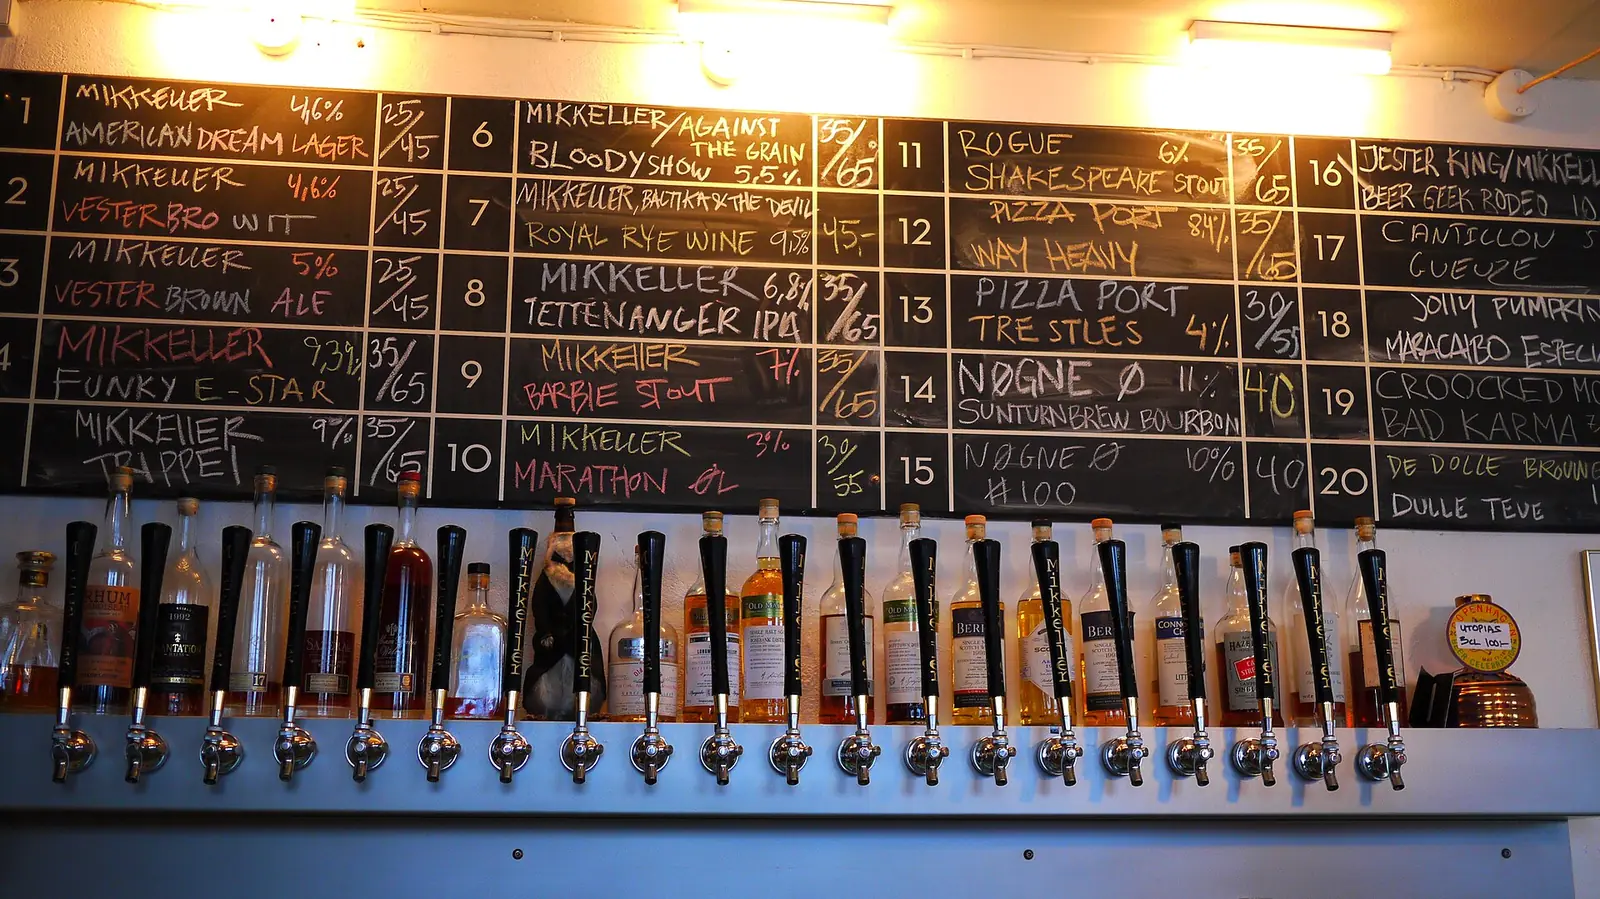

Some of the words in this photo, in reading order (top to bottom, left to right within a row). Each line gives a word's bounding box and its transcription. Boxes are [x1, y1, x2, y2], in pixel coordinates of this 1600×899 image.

[20, 97, 31, 124] 1
[76, 83, 244, 112] MIKKELLER
[66, 120, 193, 149] AMERICAN
[197, 126, 284, 156] DREAM
[292, 133, 369, 162] LAGER
[472, 121, 493, 148] 6
[958, 129, 1073, 157] ROGUE
[1158, 140, 1190, 165] 6%
[690, 141, 737, 159] THE
[746, 141, 806, 166] GRAIN
[899, 142, 921, 169] 11
[1358, 145, 1440, 178] JESTER
[74, 160, 247, 193] MIKKELLER
[965, 162, 1168, 196] SHAKESPEARE
[1174, 173, 1231, 199] STOUT
[1309, 158, 1343, 187] 16
[5, 176, 29, 205] 2
[1361, 182, 1416, 212] BEER
[1423, 186, 1476, 214] GEEK
[1482, 187, 1549, 217] RODEO
[233, 213, 318, 236] WIT
[469, 199, 490, 226] 7
[989, 200, 1077, 226] PIZZA
[1089, 202, 1179, 234] PORT
[525, 221, 608, 252] ROYAL
[621, 223, 679, 253] RYE
[686, 230, 759, 256] WINE
[899, 217, 932, 247] 12
[1382, 220, 1556, 249] CANTILLON
[69, 239, 253, 275] MIKKELLER
[291, 252, 339, 281] 5%
[971, 237, 1028, 273] WAY
[1044, 238, 1139, 277] HEAVY
[1313, 235, 1345, 263] 17
[0, 259, 21, 287] 3
[541, 262, 761, 303] MIKKELLER
[1409, 251, 1540, 288] GUEUZE
[55, 279, 161, 309] VESTER
[165, 284, 251, 315] BROWN
[270, 287, 333, 318] ALE
[464, 278, 486, 307] 8
[975, 277, 1084, 312] PIZZA
[1097, 280, 1190, 318] PORT
[899, 296, 934, 324] 13
[1317, 310, 1351, 338] 18
[753, 310, 802, 344] IPA
[1185, 313, 1230, 356] 4%
[57, 324, 274, 368] MIKKELLER
[461, 359, 484, 389] 9
[756, 347, 802, 385] 7%
[53, 367, 177, 403] FUNKY
[523, 379, 620, 415] BARBIE
[635, 376, 734, 410] STOUT
[900, 374, 937, 404] 14
[1244, 368, 1297, 420] 40
[1375, 370, 1565, 404] CROOCKED
[1321, 388, 1355, 416] 19
[312, 417, 354, 451] 9%
[1139, 407, 1241, 437] BOURBON
[1380, 406, 1446, 442] BAD
[1460, 409, 1579, 444] KARMA
[521, 423, 692, 458] MIKKELLER
[747, 430, 791, 458] 3%
[448, 443, 493, 473] 10
[899, 456, 936, 486] 15
[1186, 446, 1236, 484] 10%
[1386, 453, 1419, 479] DE
[1430, 452, 1506, 478] DOLLE
[514, 458, 669, 499] MARATHON
[984, 476, 1078, 508] #100
[1256, 455, 1305, 496] 40
[1319, 470, 1369, 498] 20
[1392, 492, 1469, 519] DULLE
[1480, 497, 1546, 522] TEVE
[511, 546, 534, 675] Mikkeller
[579, 550, 597, 678] Mikkeller
[1046, 558, 1071, 683] Mikkeller
[1459, 624, 1502, 635] UTOPIAS
[253, 674, 266, 687] 17
